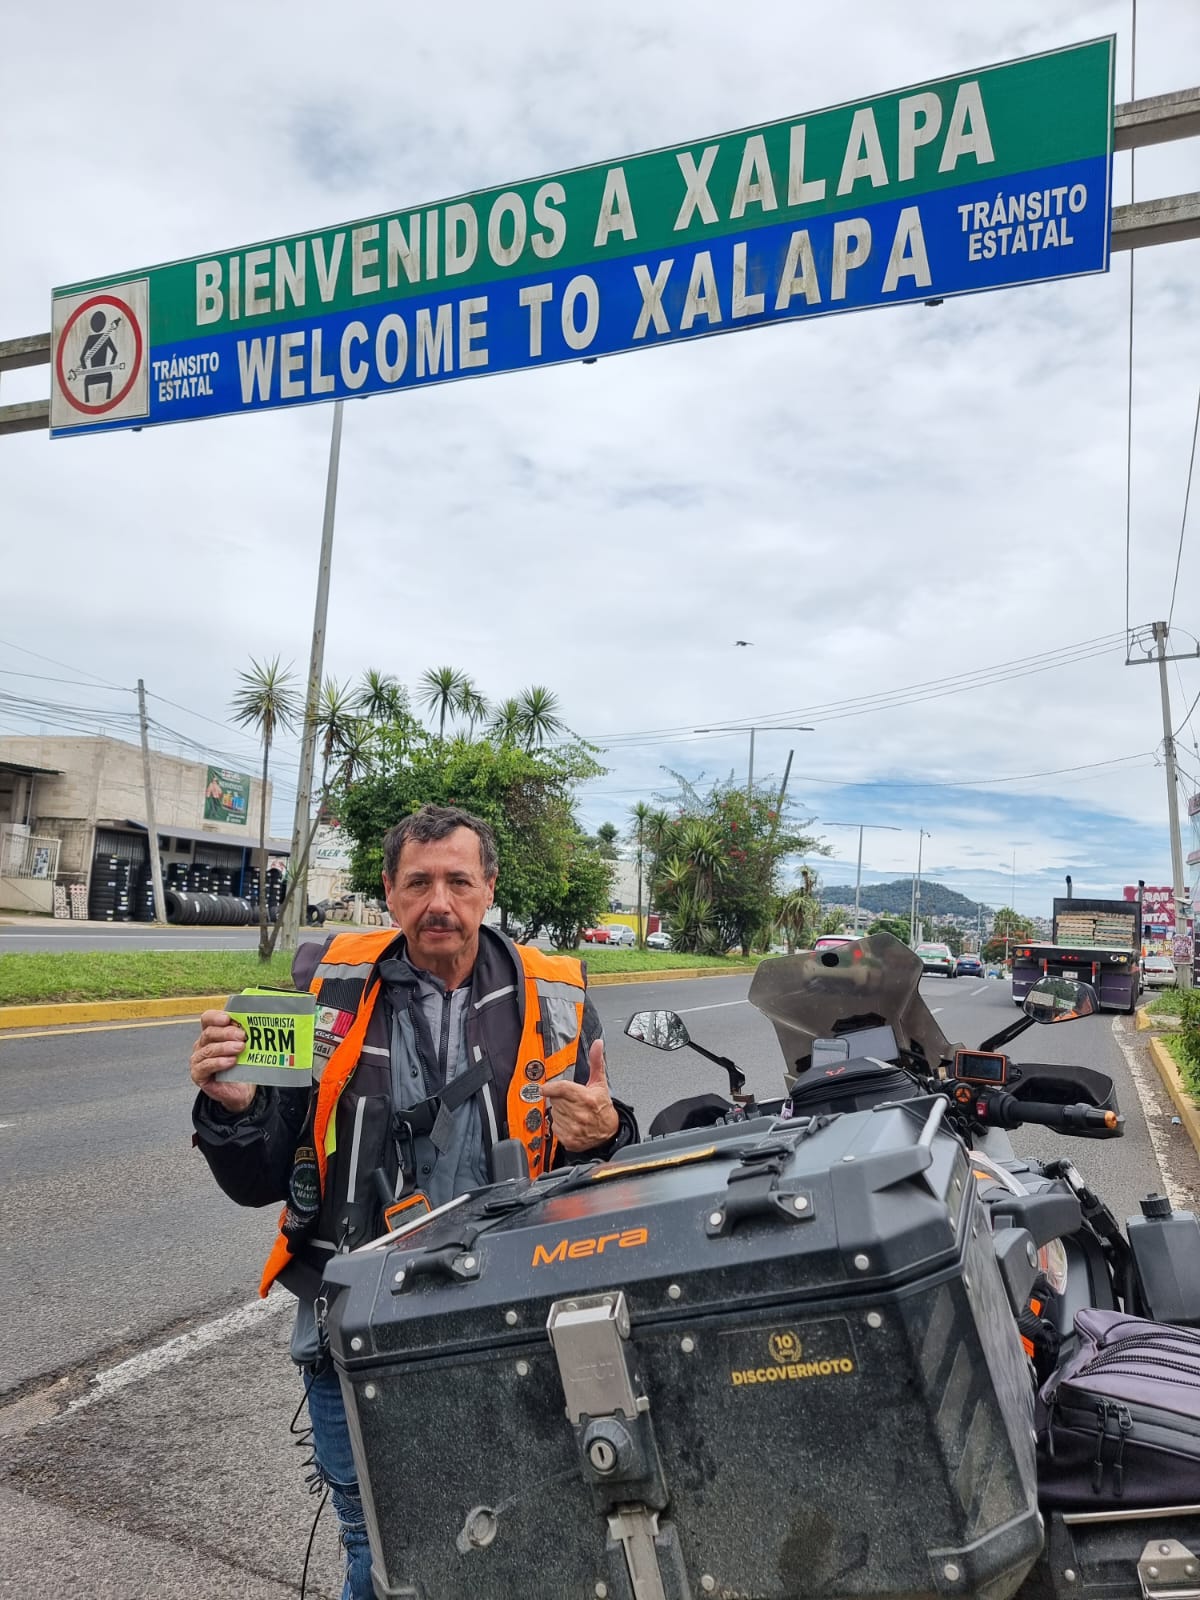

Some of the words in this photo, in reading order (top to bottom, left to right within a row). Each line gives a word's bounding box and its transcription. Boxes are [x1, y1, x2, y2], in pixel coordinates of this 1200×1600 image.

[196, 182, 566, 325] BIENVENIDOS
[594, 167, 637, 247] A
[673, 81, 995, 231] XALAPA
[958, 183, 1088, 231] TRÁNSITO
[968, 218, 1074, 262] ESTATAL
[238, 296, 488, 403] WELCOME
[520, 275, 599, 356] TO
[633, 207, 931, 339] XALAPA
[152, 351, 219, 381] TRÁNSITO
[158, 375, 213, 402] ESTATAL
[247, 1016, 295, 1028] MOTOTURISTA
[249, 1027, 295, 1054] RRM
[246, 1052, 277, 1065] MÉXICO
[531, 1226, 648, 1268] Mera
[774, 1334, 794, 1350] 10
[731, 1358, 853, 1386] DISCOVERMOTO
